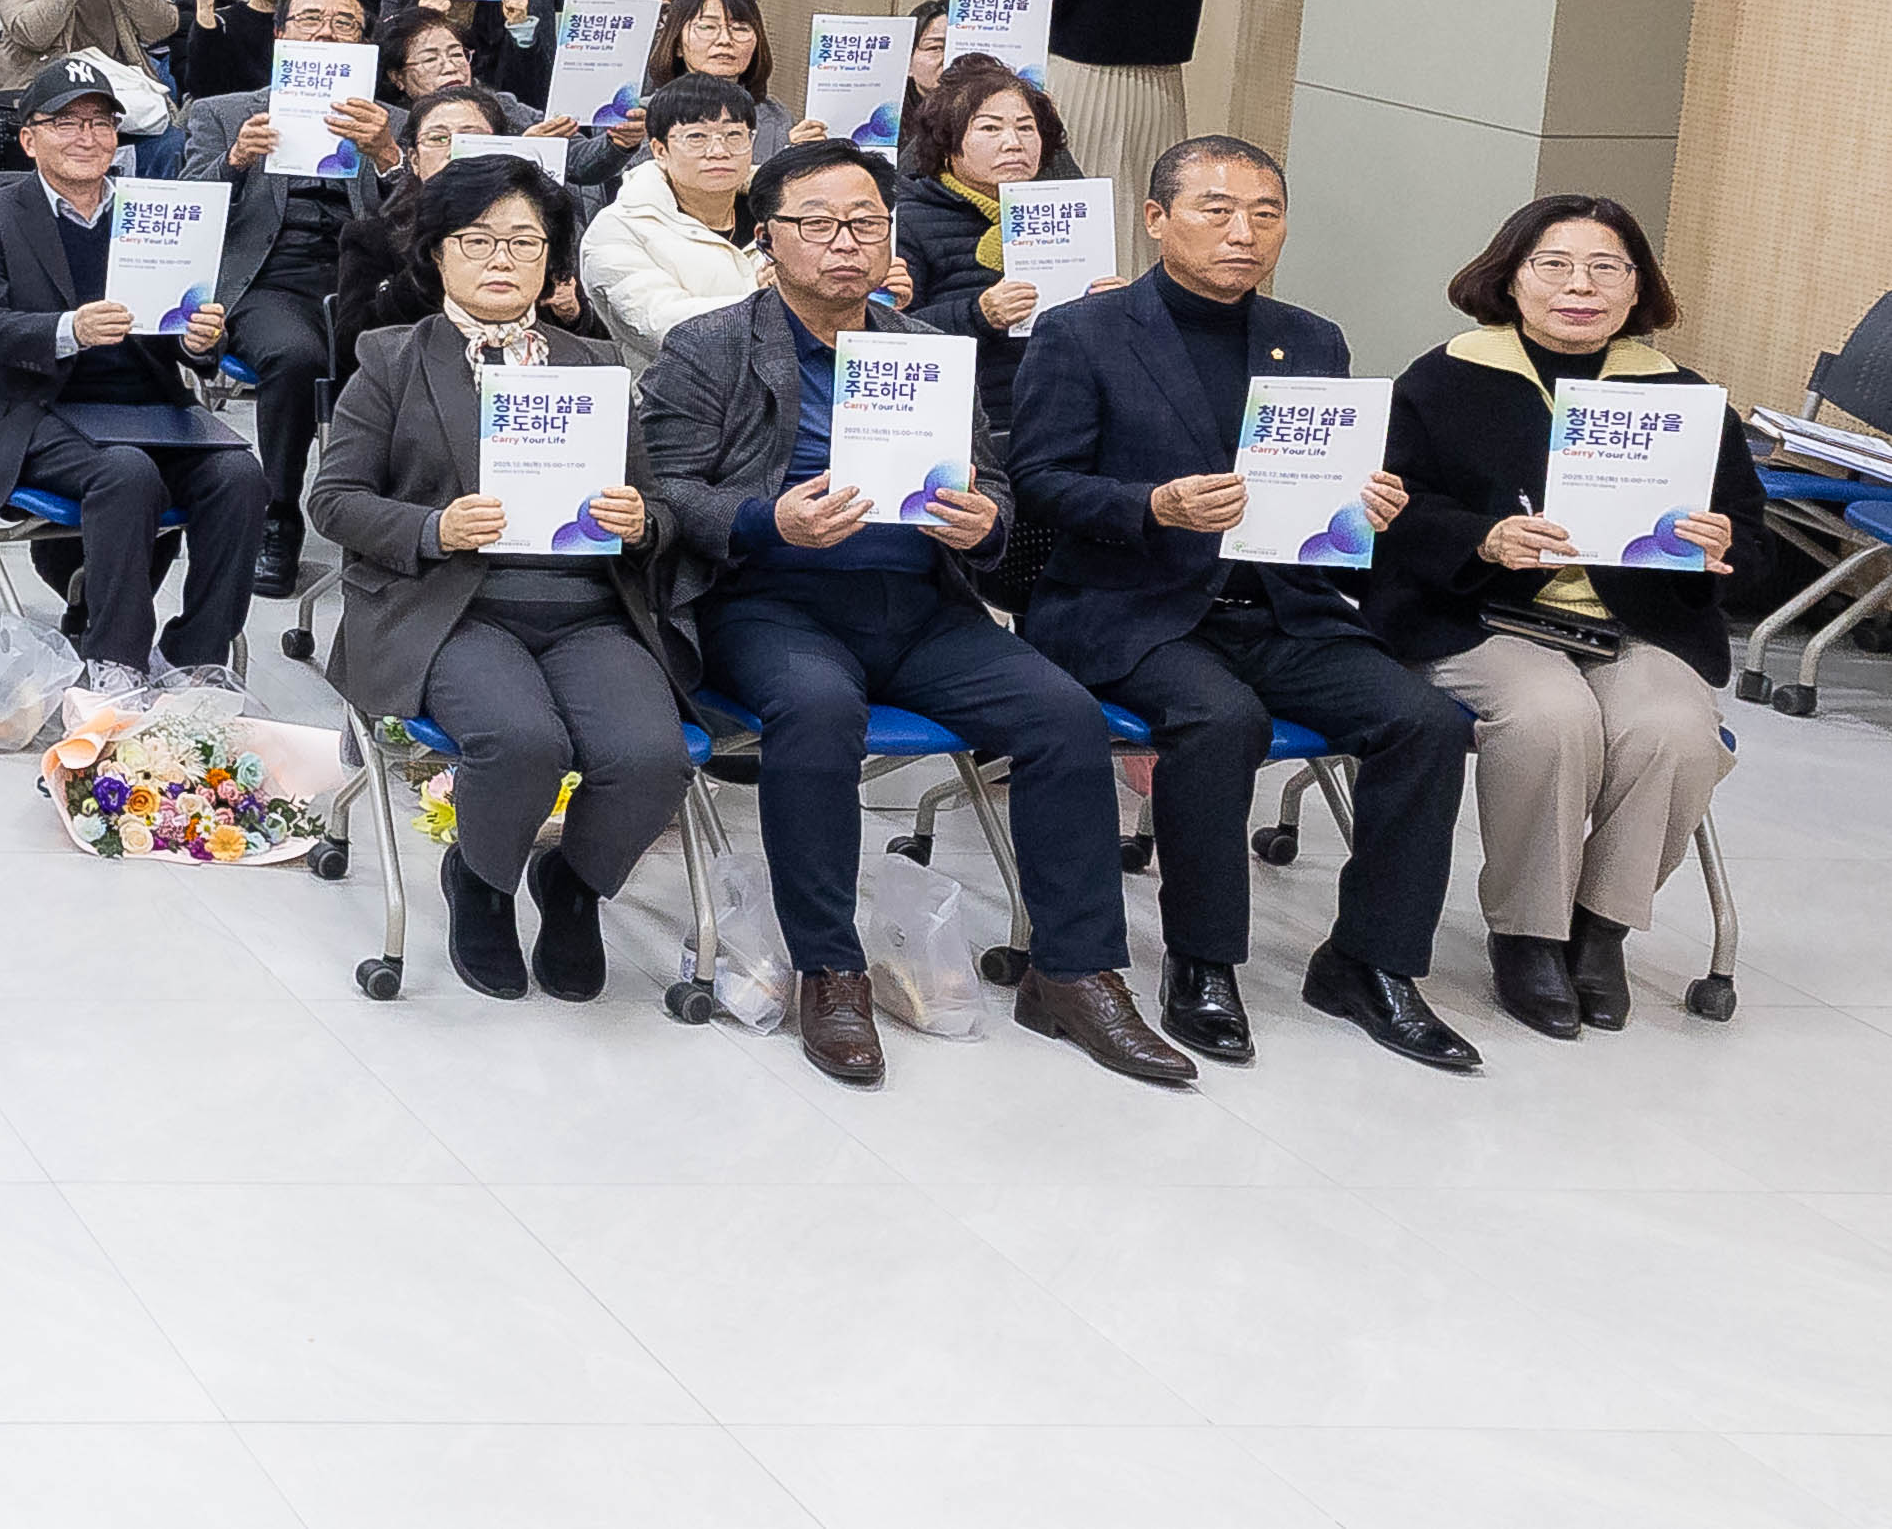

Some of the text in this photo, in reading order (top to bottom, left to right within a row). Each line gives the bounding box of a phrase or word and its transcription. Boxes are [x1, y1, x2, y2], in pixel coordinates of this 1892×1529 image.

[821, 34, 894, 49] 청년의 삶을
[819, 48, 874, 63] 주도하다
[846, 358, 942, 382] 청년의 삶을
[844, 379, 917, 400] 주도하다
[494, 393, 596, 414] 청년의 삶을
[843, 399, 915, 412] Carry Your Life
[493, 413, 569, 433] 주도하다
[1259, 404, 1361, 426] 청년의 삶을
[1568, 407, 1686, 432] 청년의 삶을
[492, 433, 568, 445] Carry Your Life
[1255, 424, 1332, 445] 주도하다
[1565, 426, 1653, 450] 주도하다
[1252, 444, 1328, 456] Carry Your Life
[1562, 446, 1650, 460] Carry Your Life
